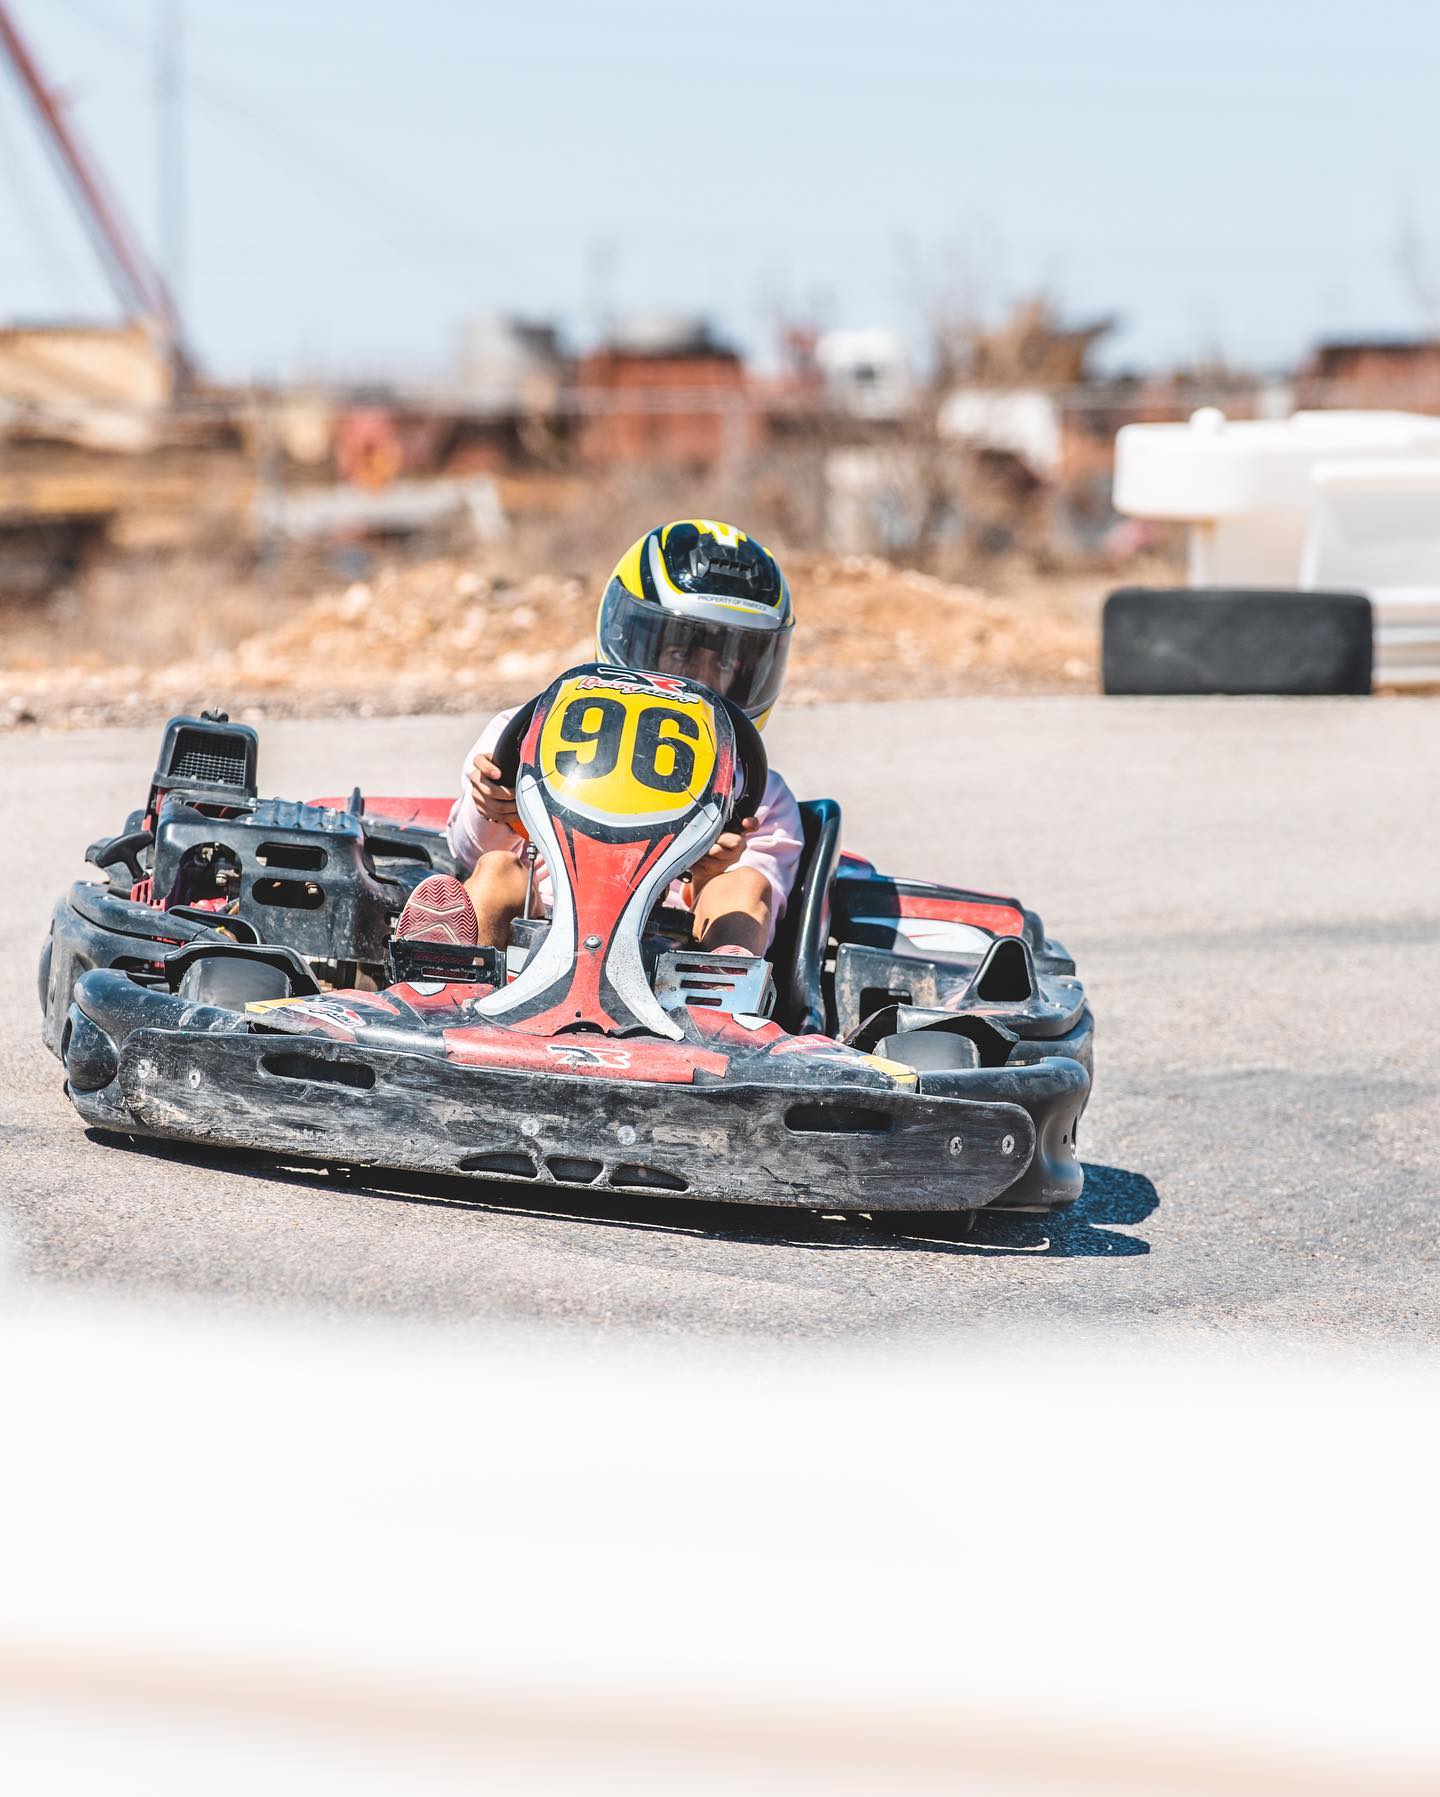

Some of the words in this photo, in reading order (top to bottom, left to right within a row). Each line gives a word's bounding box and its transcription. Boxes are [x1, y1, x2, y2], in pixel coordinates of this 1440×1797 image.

[698, 595, 731, 604] PROPERTY
[732, 598, 742, 606] OF
[555, 697, 699, 793] 96
